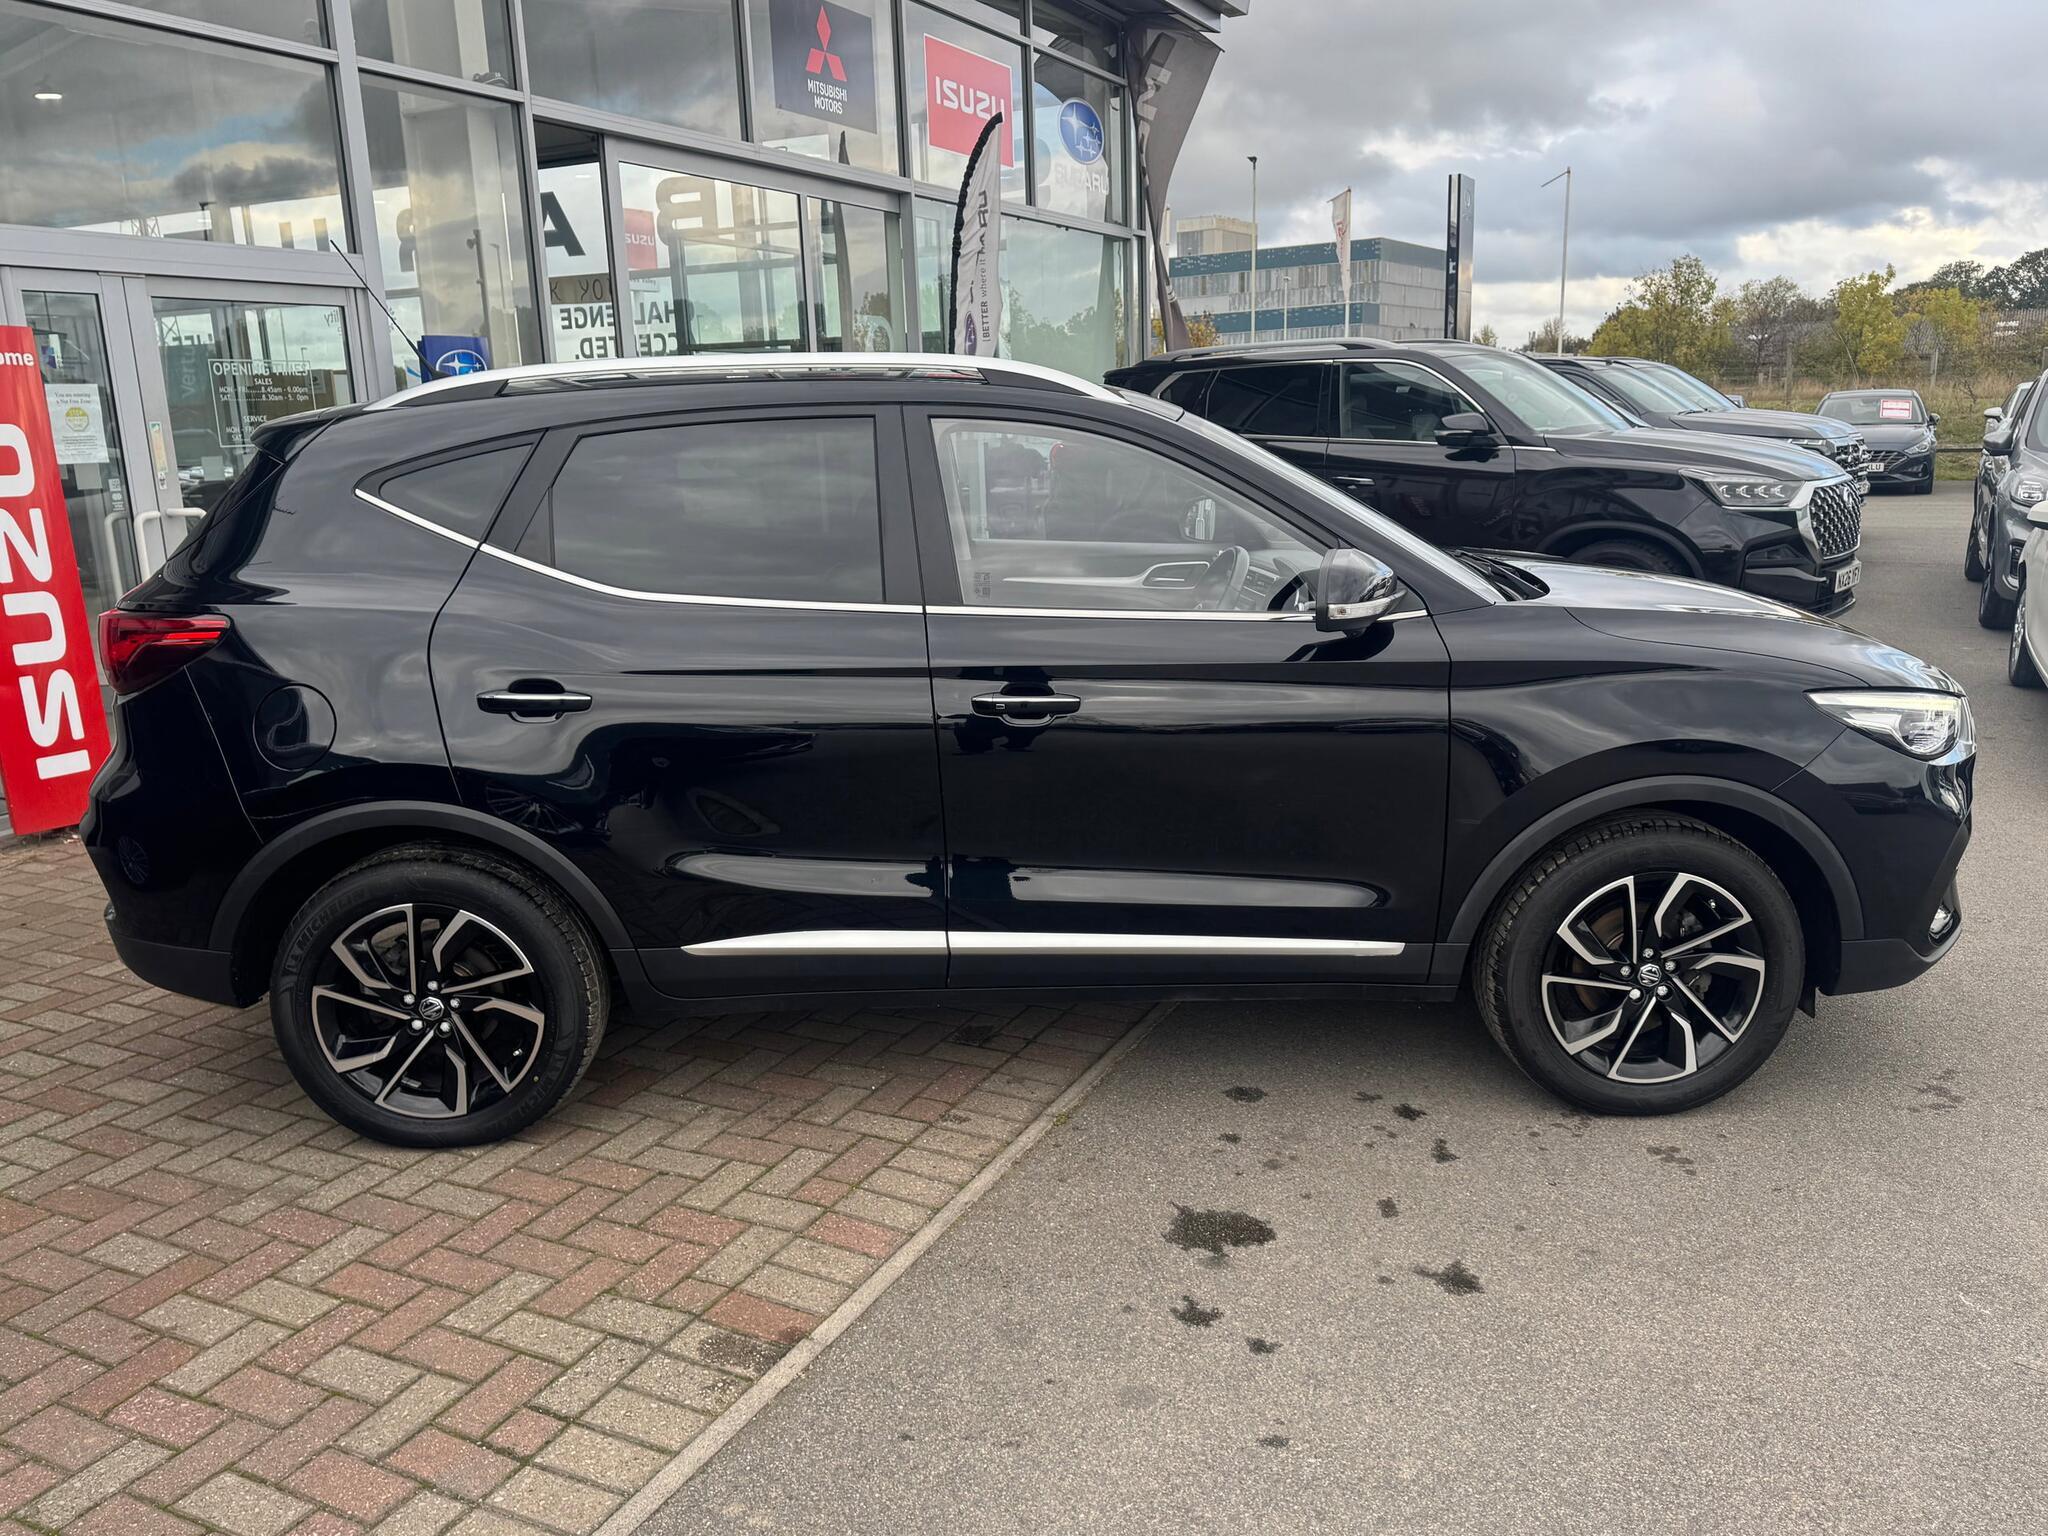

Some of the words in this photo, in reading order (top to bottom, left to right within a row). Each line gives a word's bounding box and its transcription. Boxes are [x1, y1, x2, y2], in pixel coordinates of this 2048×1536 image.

[807, 78, 848, 102] MITSUBISHI
[935, 75, 1005, 122] ISUZU
[814, 95, 843, 115] MOTORS
[624, 232, 655, 246] SUZU
[212, 362, 270, 376] OPENING
[272, 362, 309, 376] TIMES
[254, 378, 273, 386] SALES
[0, 424, 91, 780] ISUZU
